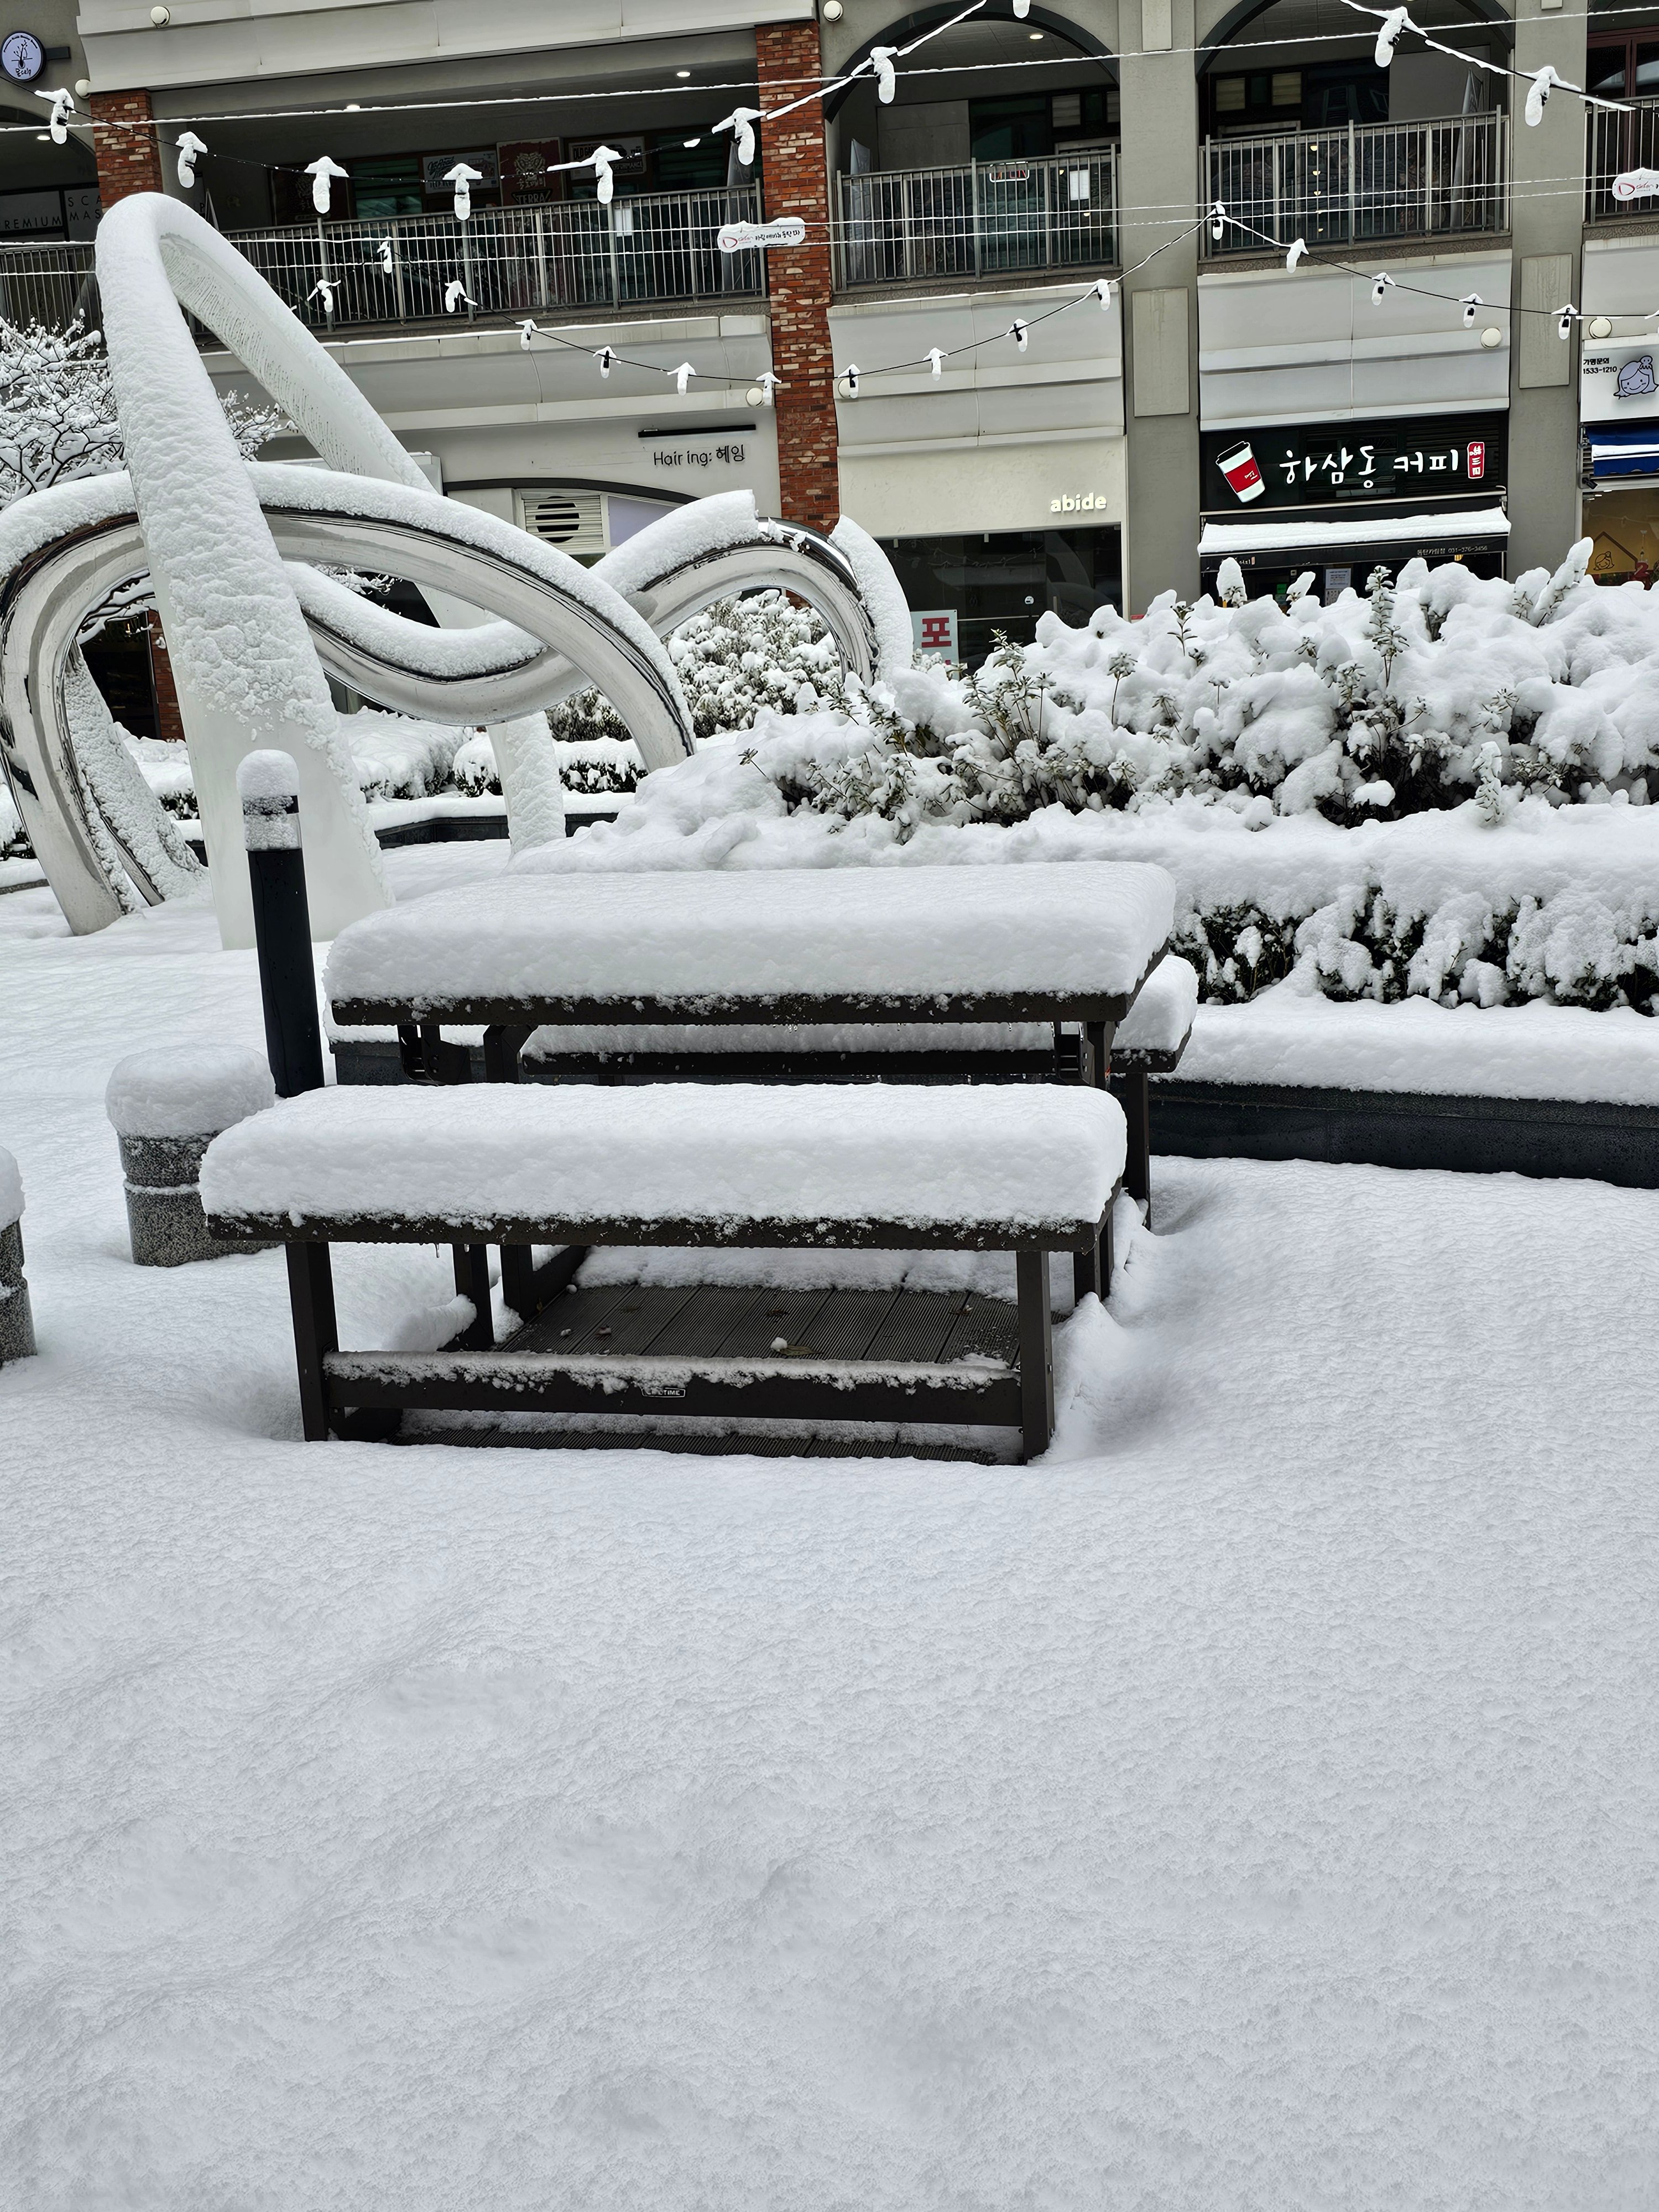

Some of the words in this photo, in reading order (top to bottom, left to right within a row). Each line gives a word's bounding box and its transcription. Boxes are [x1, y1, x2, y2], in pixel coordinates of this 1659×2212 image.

[0, 216, 61, 229] REMIUM
[1583, 357, 1610, 366] 가맹문의
[1583, 366, 1617, 374] 1533-1210
[1279, 445, 1377, 488] 하삼동
[1393, 449, 1459, 473] 커피
[1050, 492, 1107, 512] abide
[921, 617, 952, 648] 포
